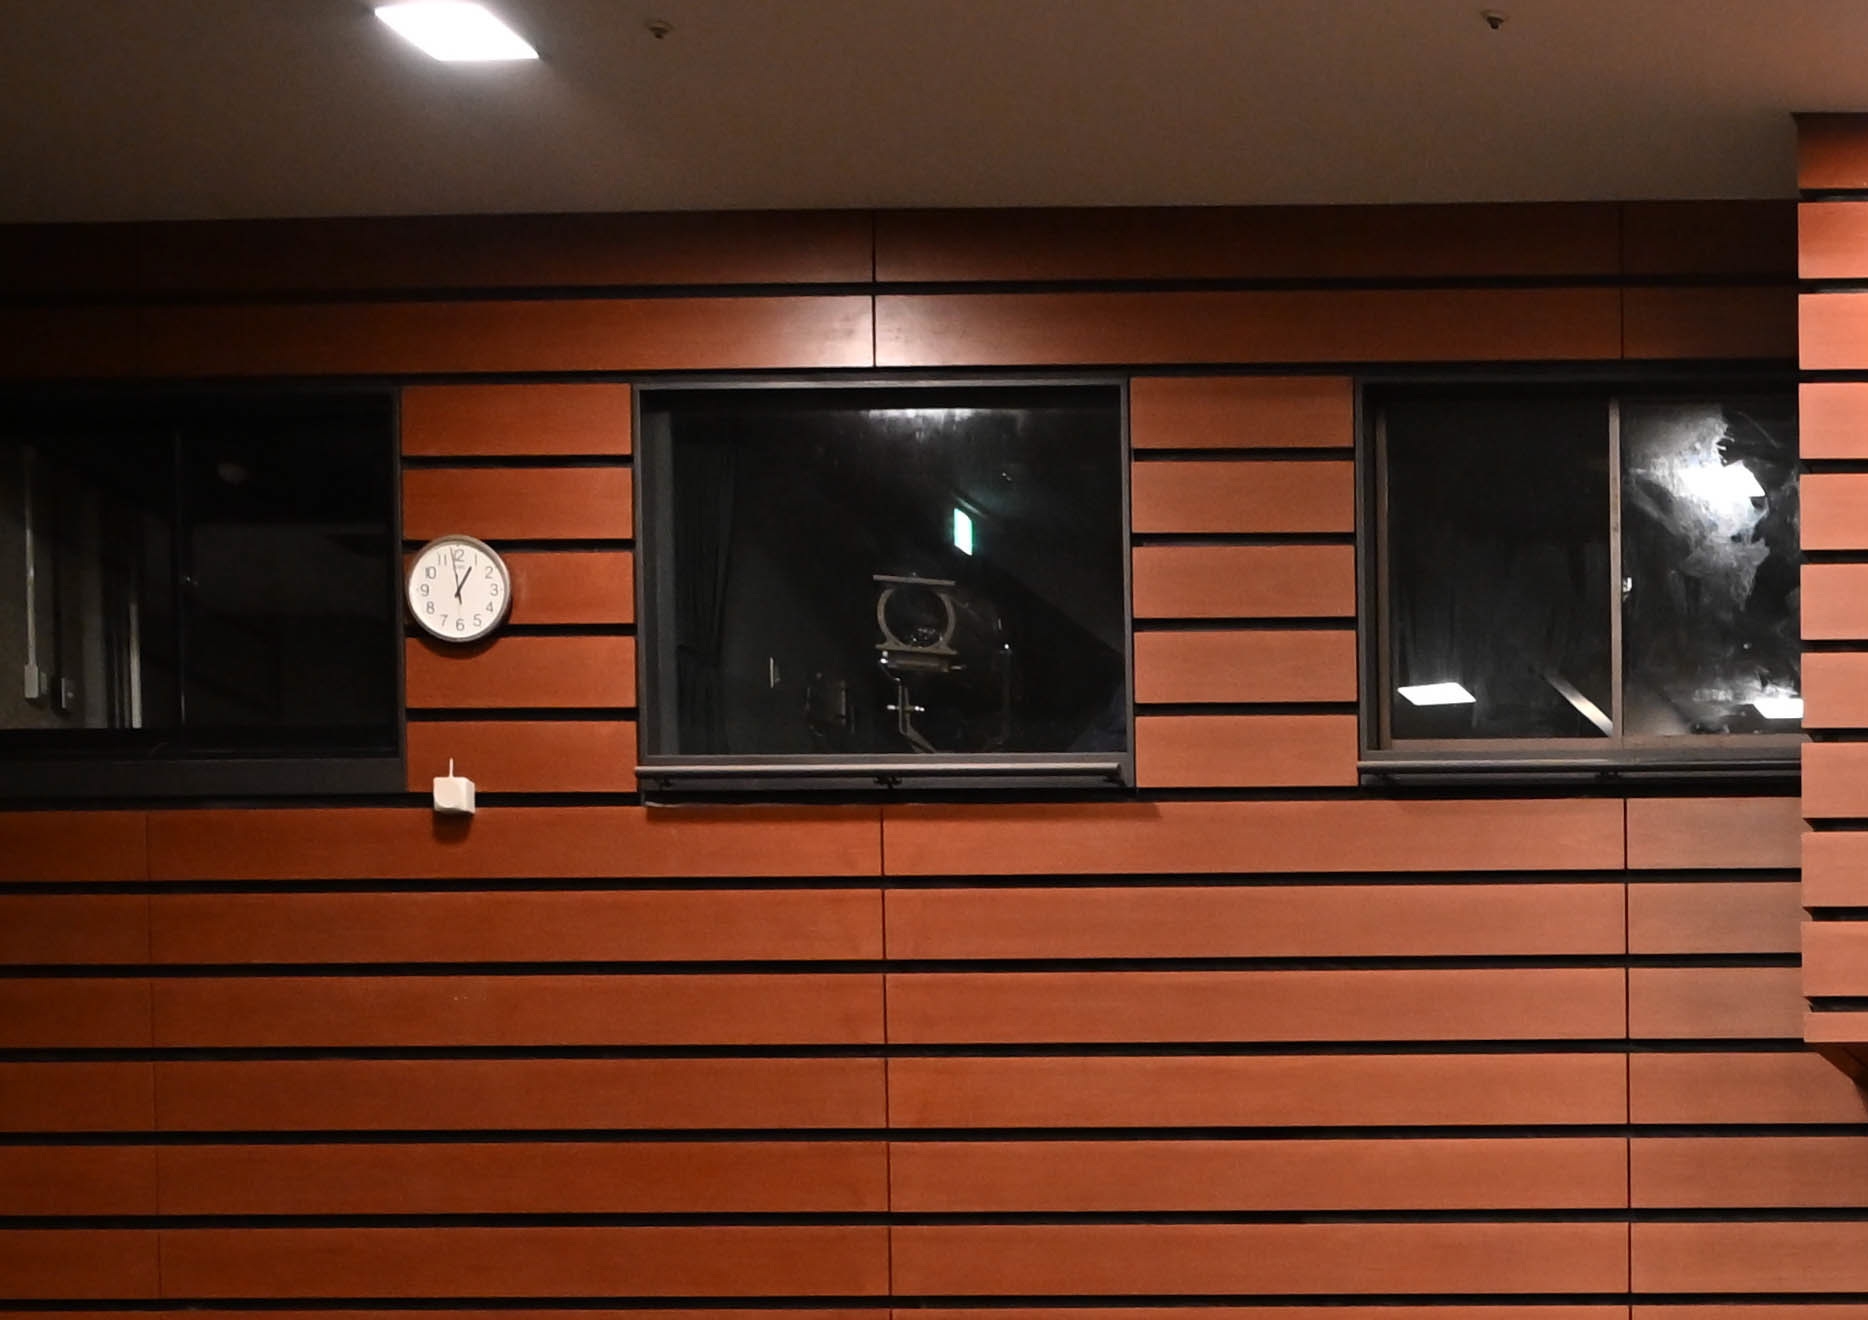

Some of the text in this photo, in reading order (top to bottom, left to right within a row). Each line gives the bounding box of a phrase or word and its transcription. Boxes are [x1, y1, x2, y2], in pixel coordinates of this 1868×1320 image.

[425, 566, 437, 580] 10
[484, 566, 494, 580] 2
[420, 583, 430, 598] 9
[490, 583, 499, 597] 3
[426, 601, 436, 615] 8
[485, 601, 494, 613] 4
[440, 614, 449, 628] 7
[455, 618, 465, 632] 6
[472, 613, 482, 628] 5
